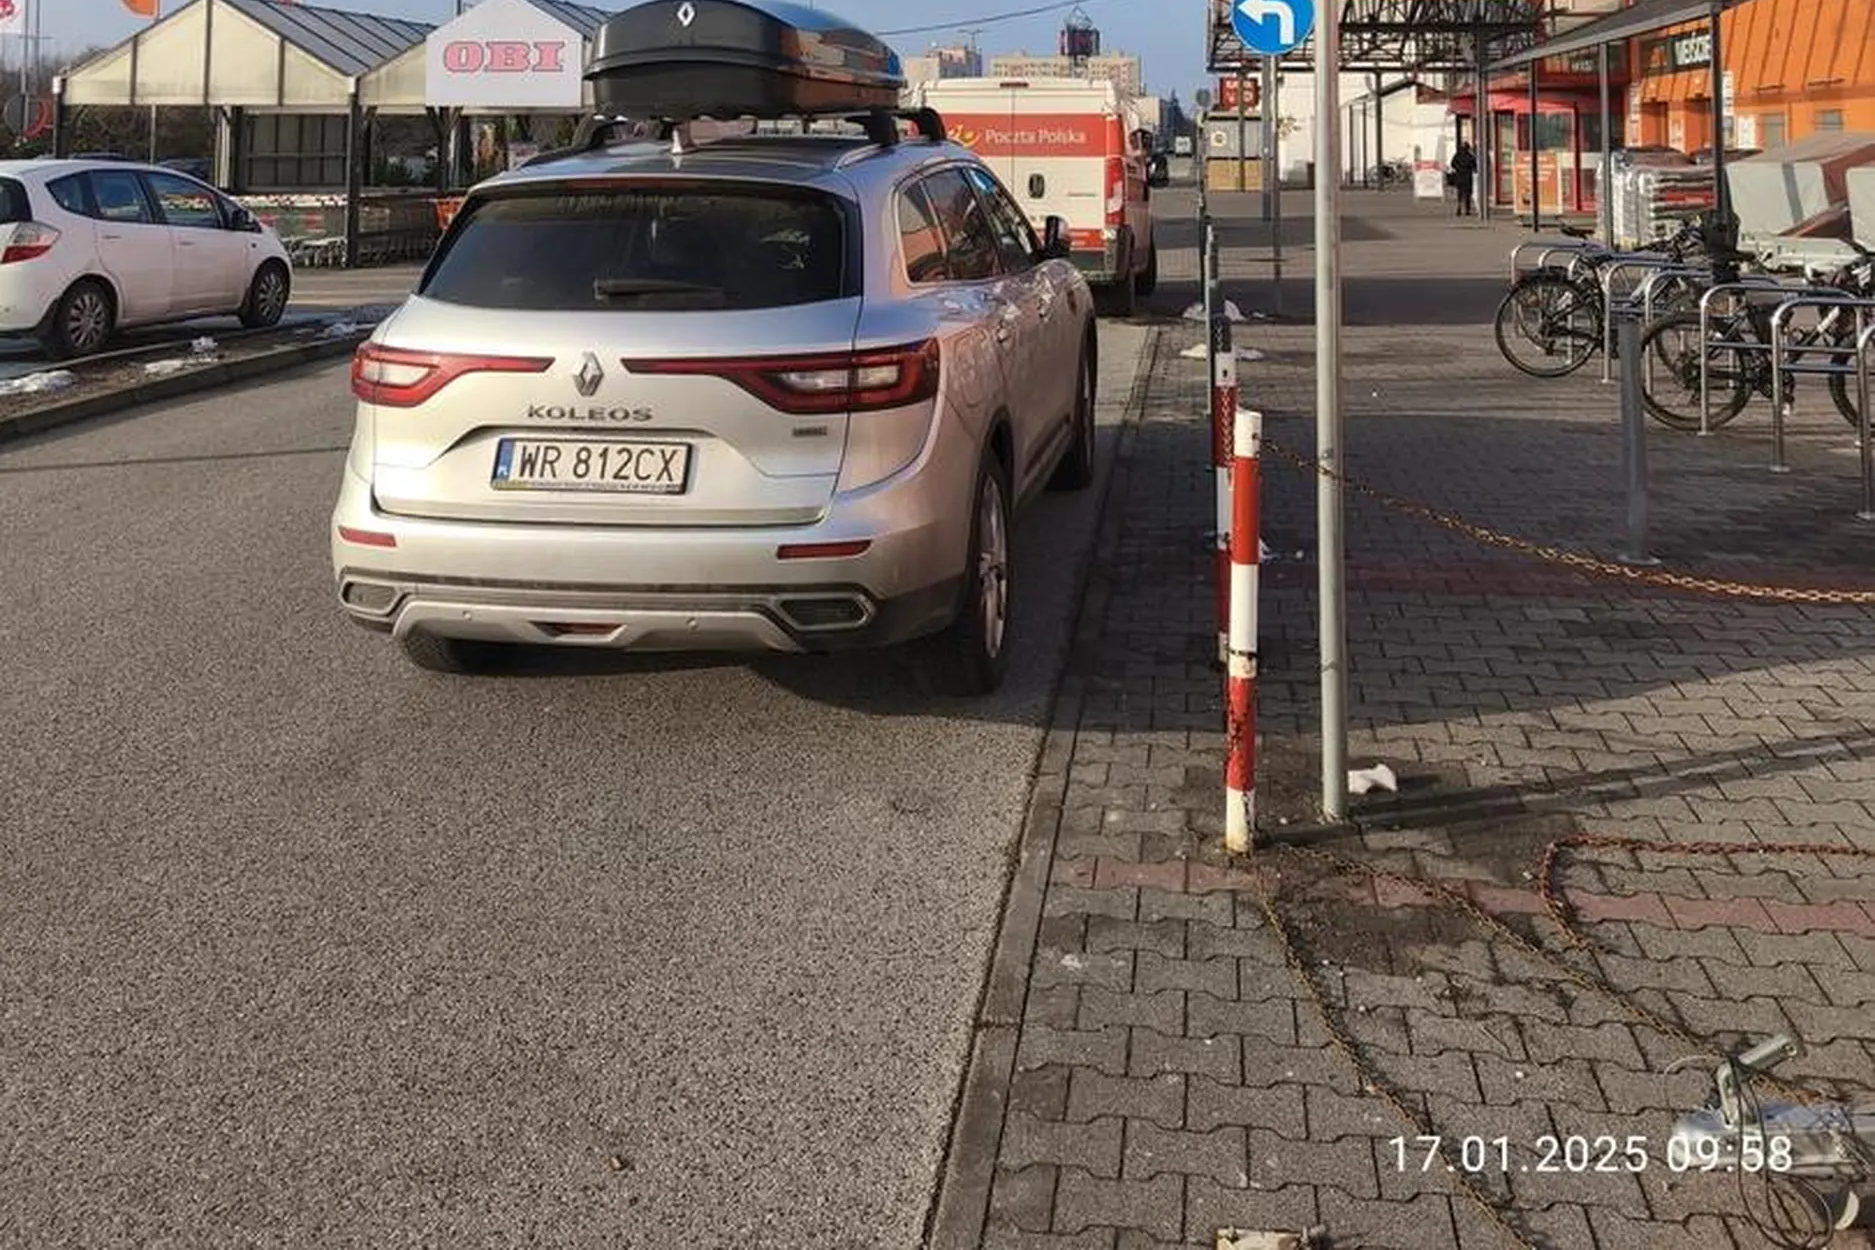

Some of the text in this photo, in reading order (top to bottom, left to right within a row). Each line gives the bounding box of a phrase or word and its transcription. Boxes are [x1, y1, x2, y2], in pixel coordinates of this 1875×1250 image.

[443, 40, 566, 73] OBI
[985, 128, 1087, 145] Poczta Polska
[527, 405, 653, 422] KOLEOS
[518, 444, 678, 482] WR 812CX
